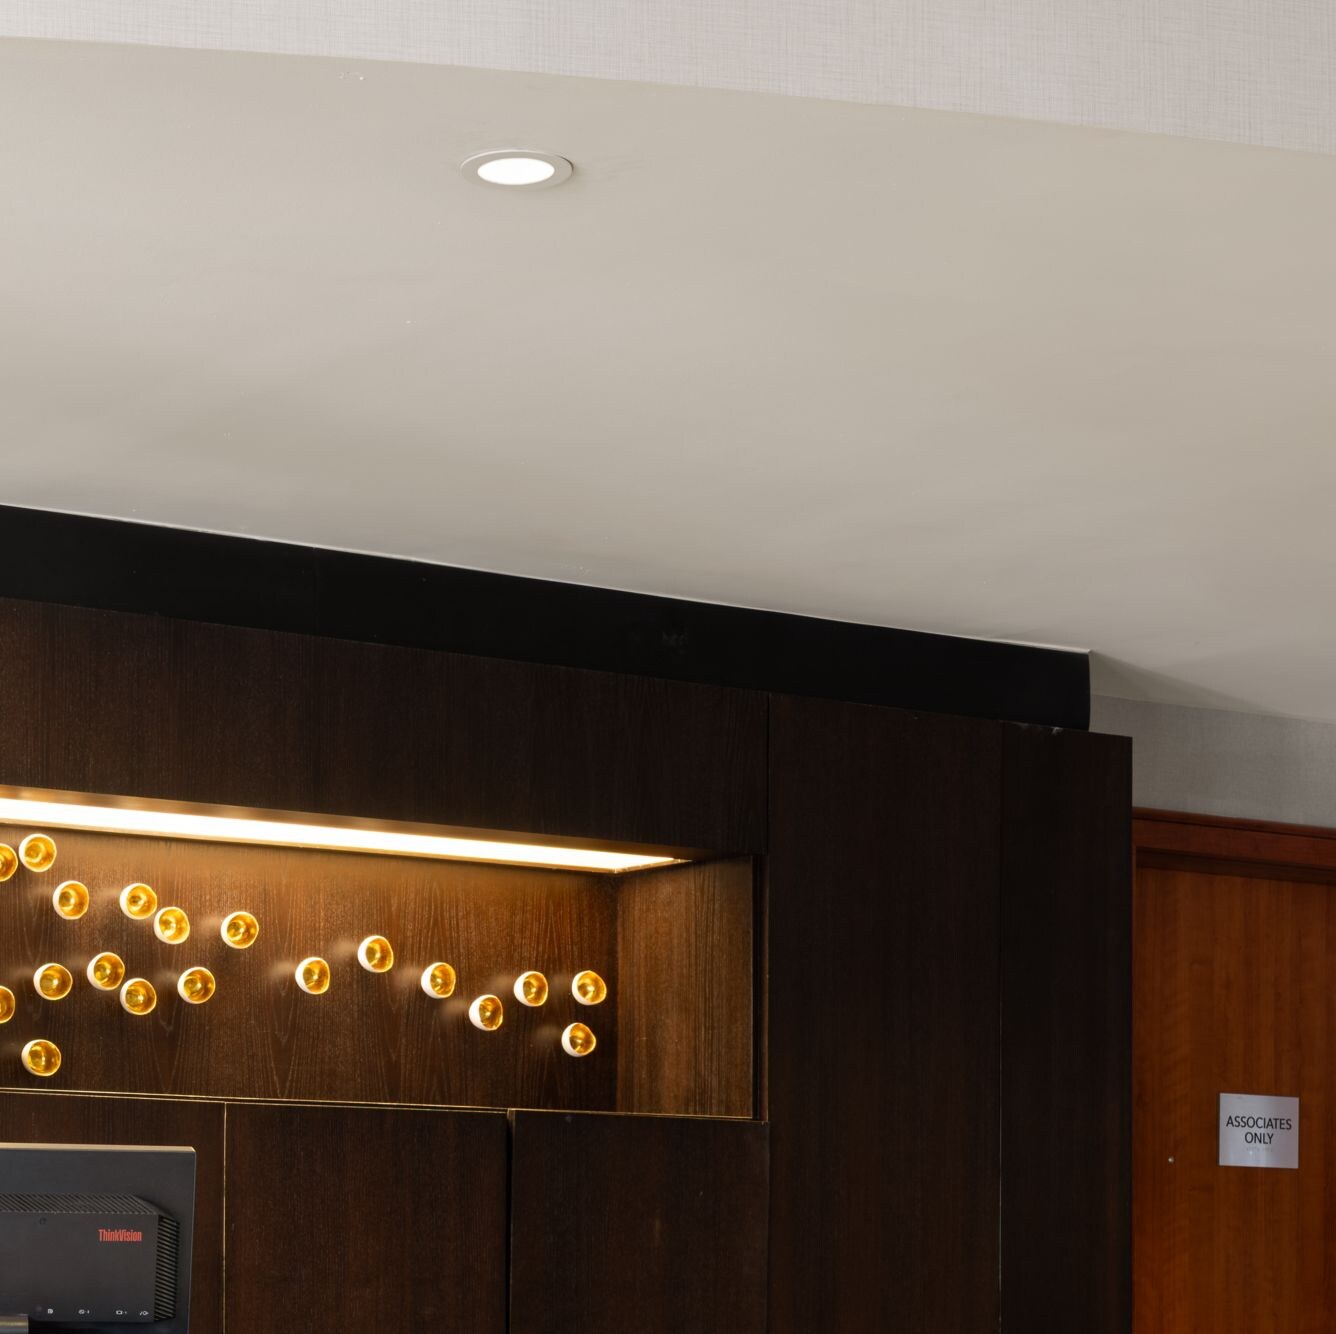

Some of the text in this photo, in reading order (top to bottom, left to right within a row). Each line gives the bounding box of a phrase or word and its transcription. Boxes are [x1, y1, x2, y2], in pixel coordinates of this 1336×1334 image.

[1226, 1115, 1292, 1130] ASSOCIATES
[1244, 1131, 1274, 1144] ONLY
[98, 1228, 142, 1242] ThinkVision
